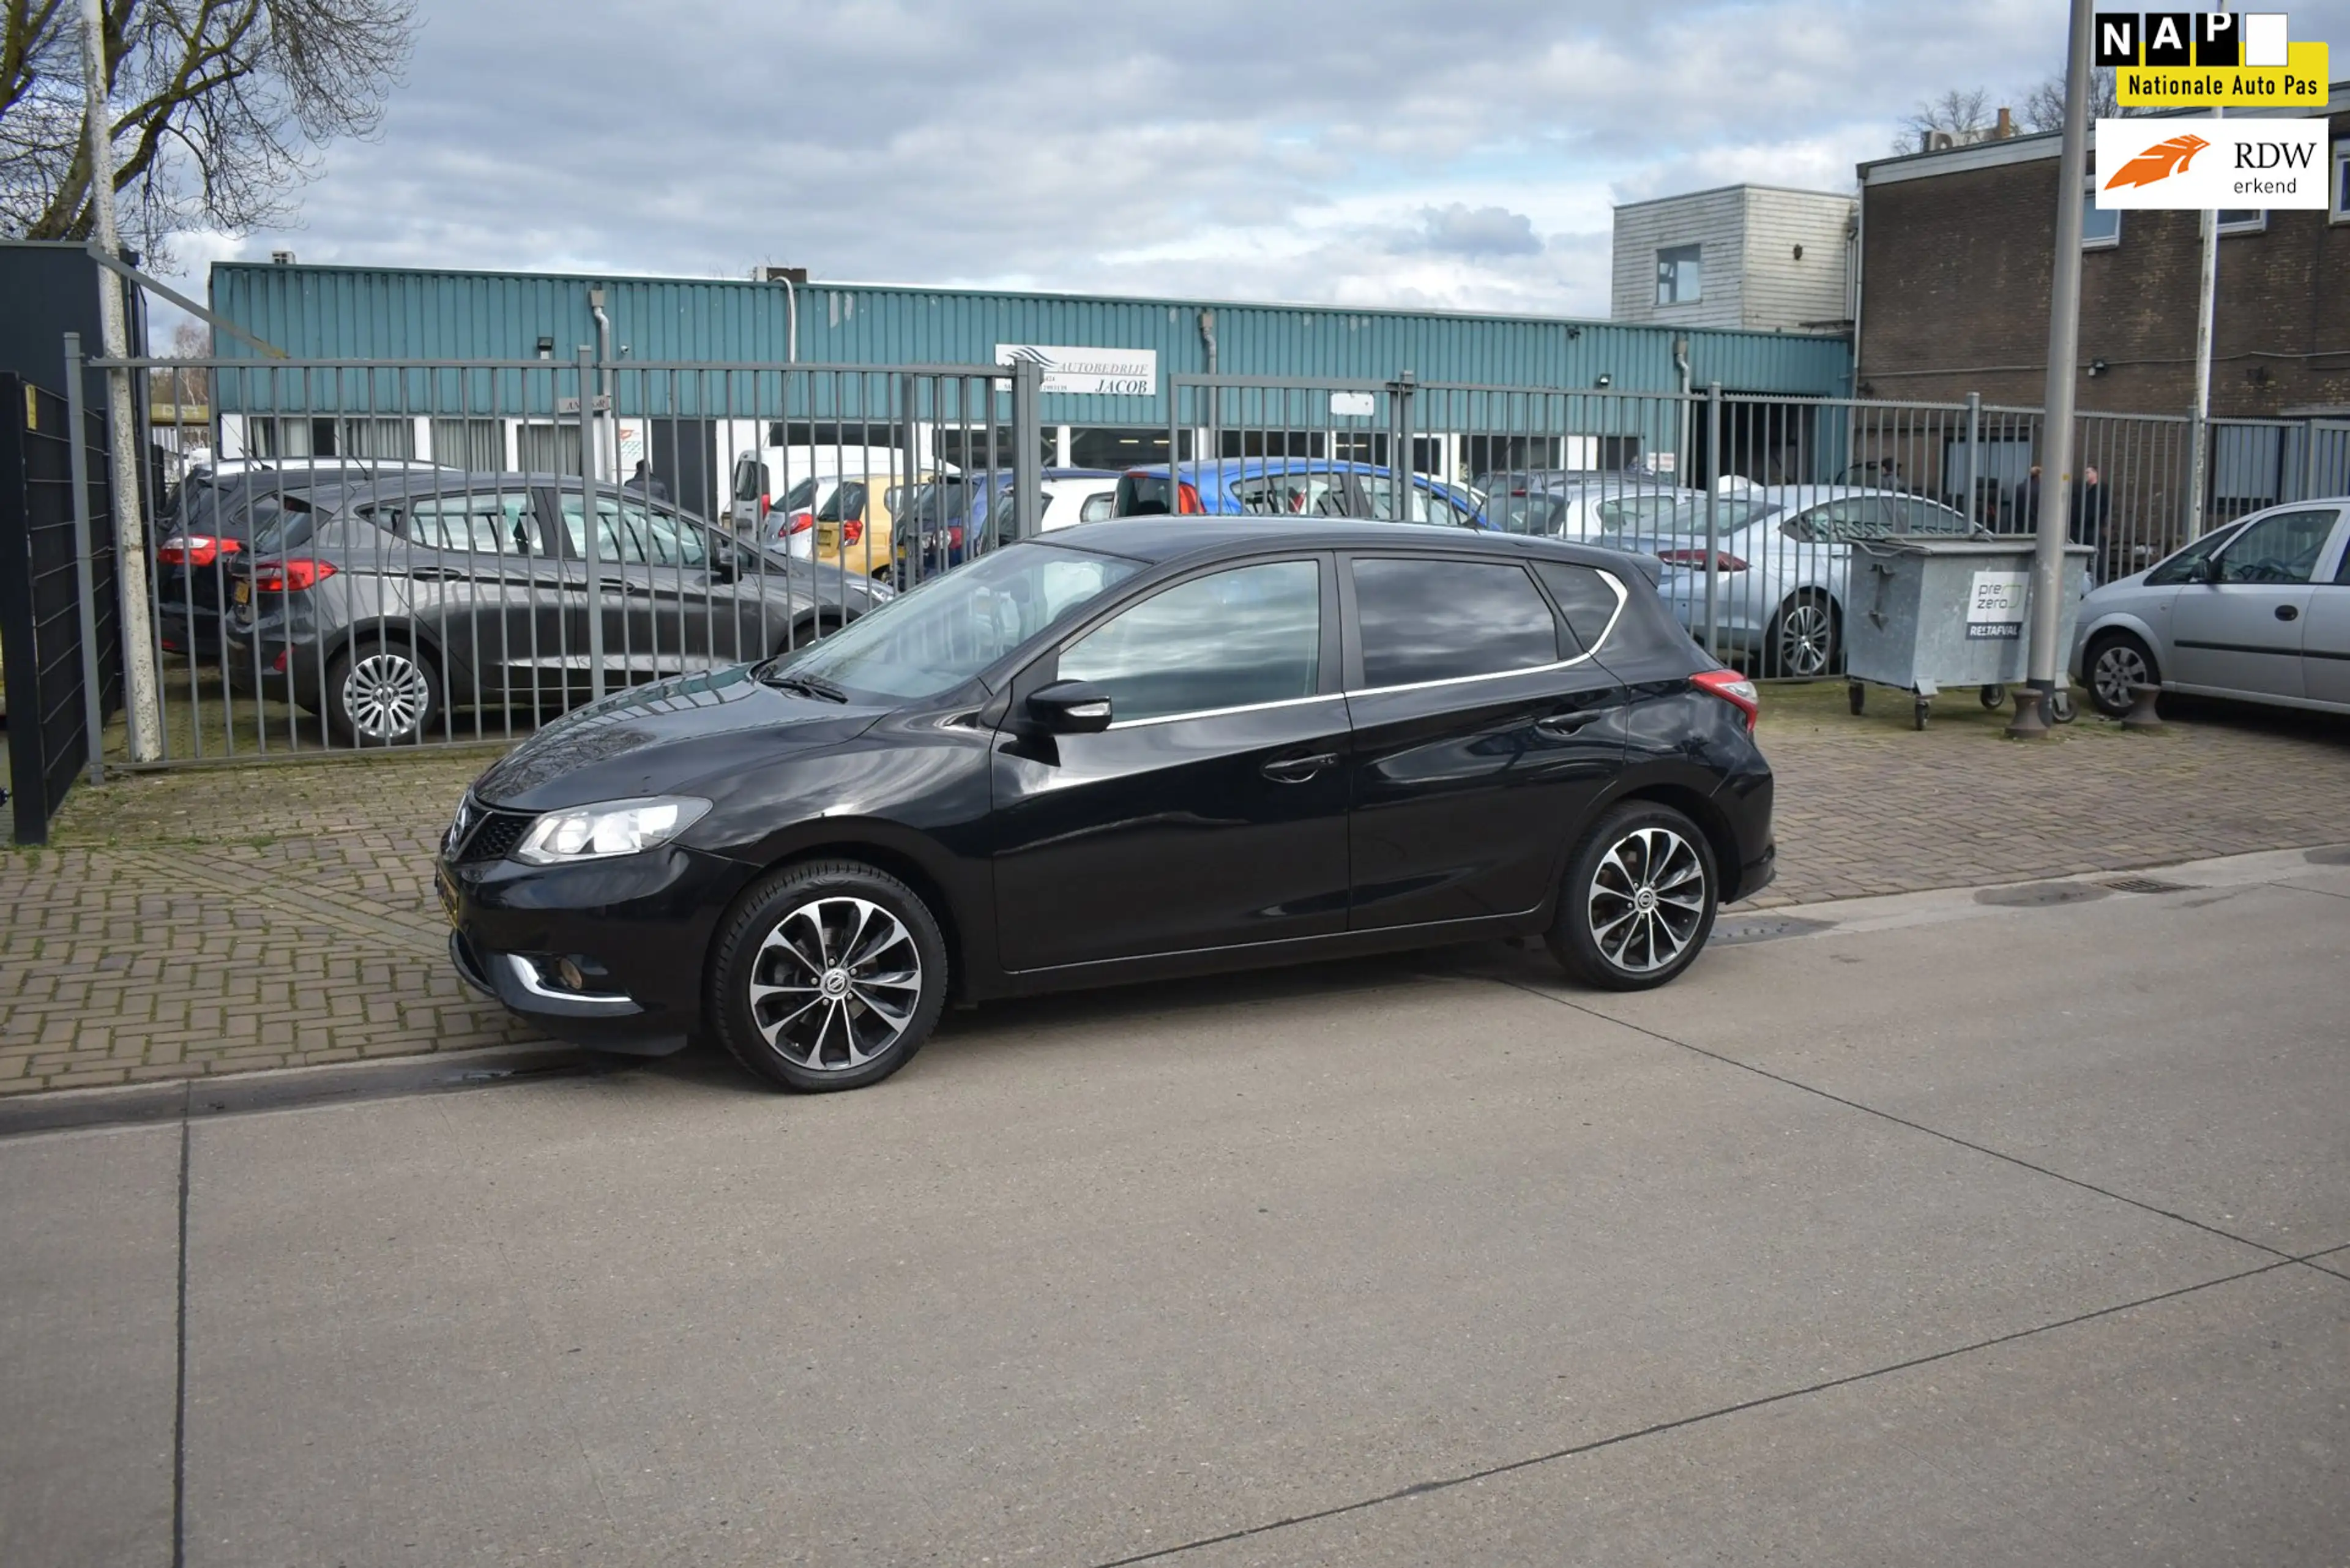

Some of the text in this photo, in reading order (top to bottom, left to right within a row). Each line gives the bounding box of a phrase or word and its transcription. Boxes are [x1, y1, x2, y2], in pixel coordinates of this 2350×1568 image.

[1058, 362, 1148, 375] AUTOBEDRIJF
[1095, 379, 1147, 394] JACOB
[1979, 584, 2002, 597] pre
[1977, 598, 2008, 609] zero
